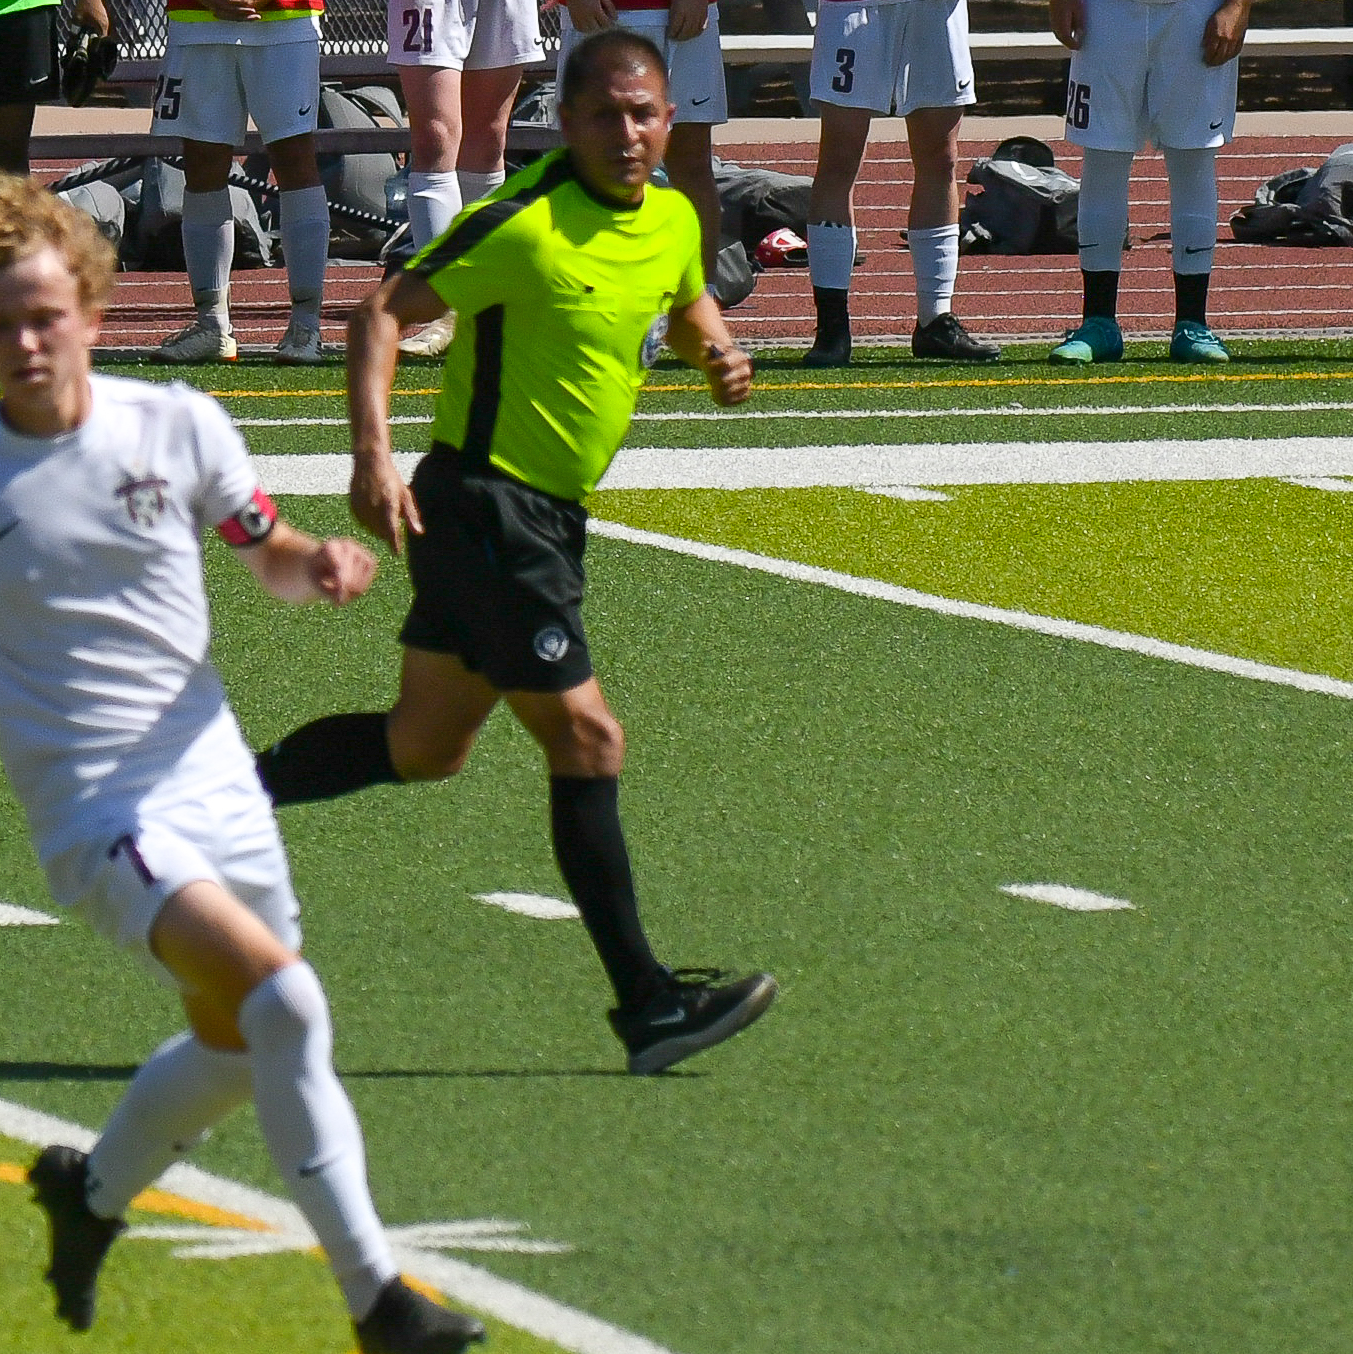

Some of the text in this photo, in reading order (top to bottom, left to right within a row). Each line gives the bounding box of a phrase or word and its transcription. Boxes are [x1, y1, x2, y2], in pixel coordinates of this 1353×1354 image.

[402, 8, 433, 53] 21
[831, 47, 856, 94] 3
[1066, 79, 1091, 130] 26
[107, 834, 156, 888] 7
